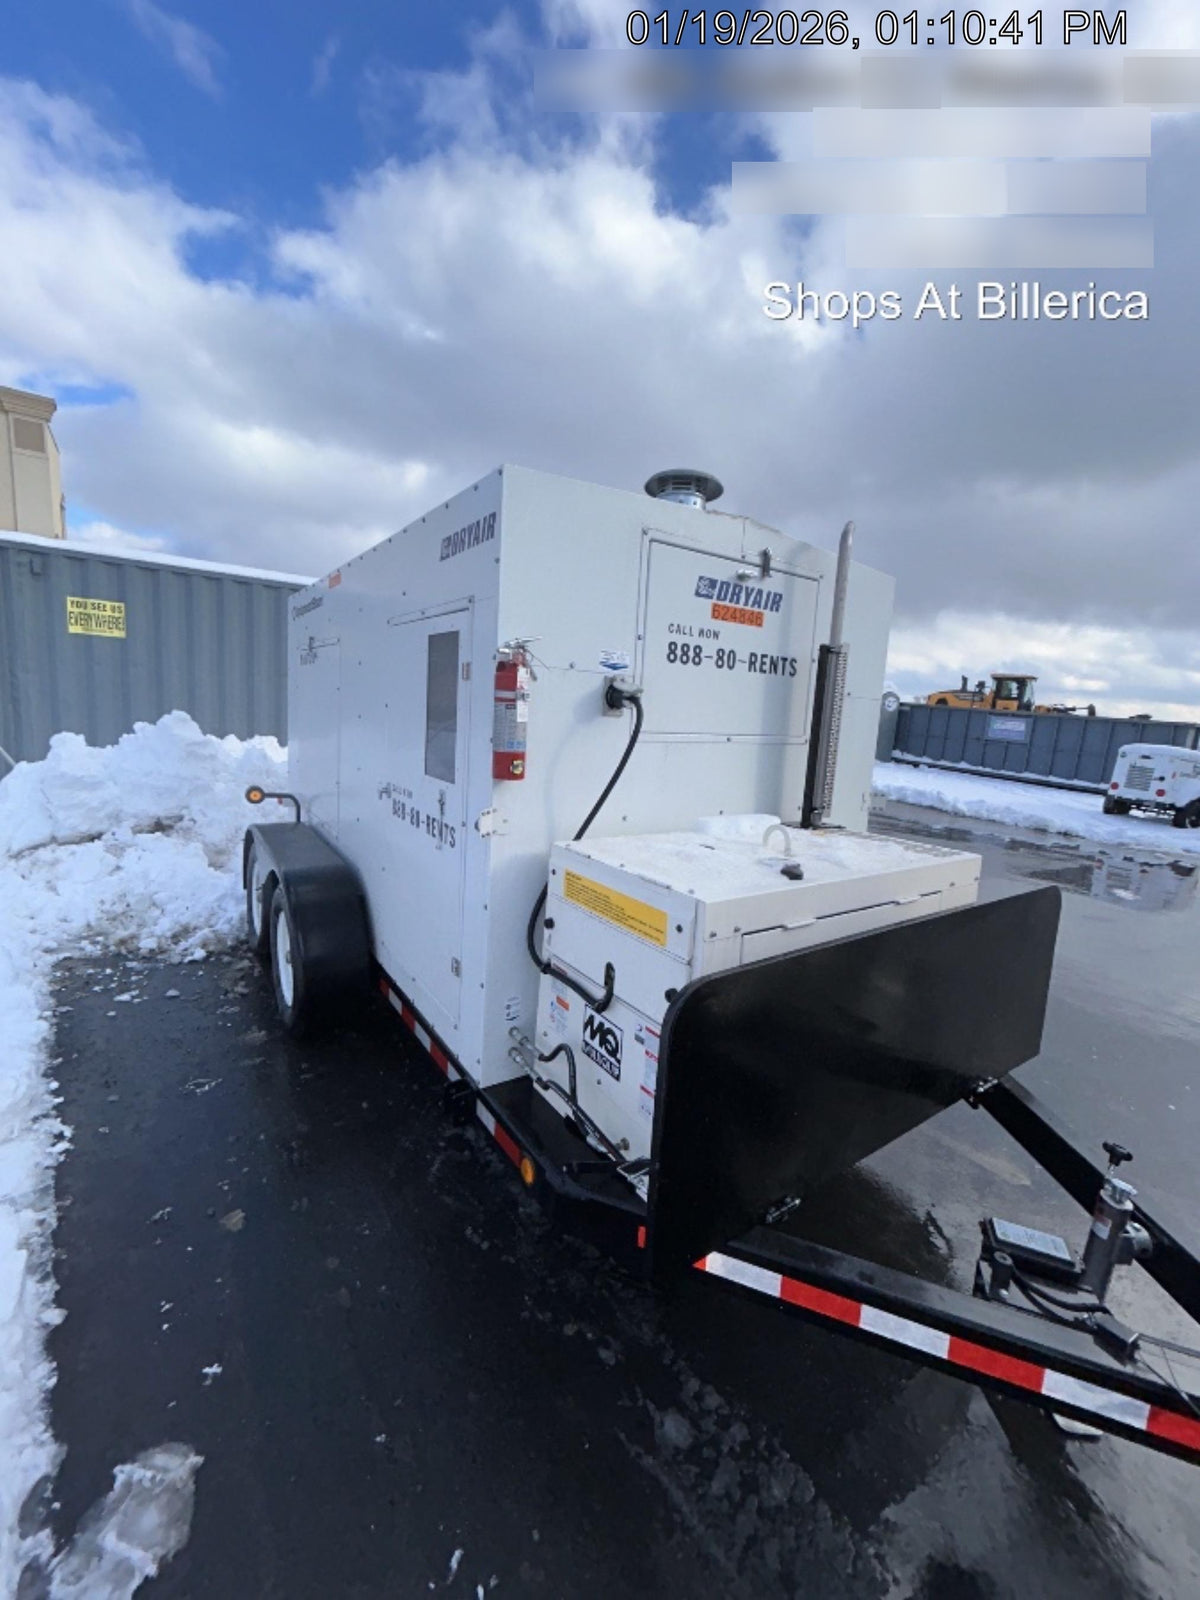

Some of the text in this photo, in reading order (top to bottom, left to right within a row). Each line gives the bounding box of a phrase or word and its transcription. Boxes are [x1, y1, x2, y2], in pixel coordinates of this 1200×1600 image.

[69, 600, 88, 610] YOU
[90, 602, 108, 612] SEE
[715, 581, 783, 612] DRYAIR
[668, 623, 720, 640] CALL NOW
[666, 641, 798, 677] 888-80-RENTS
